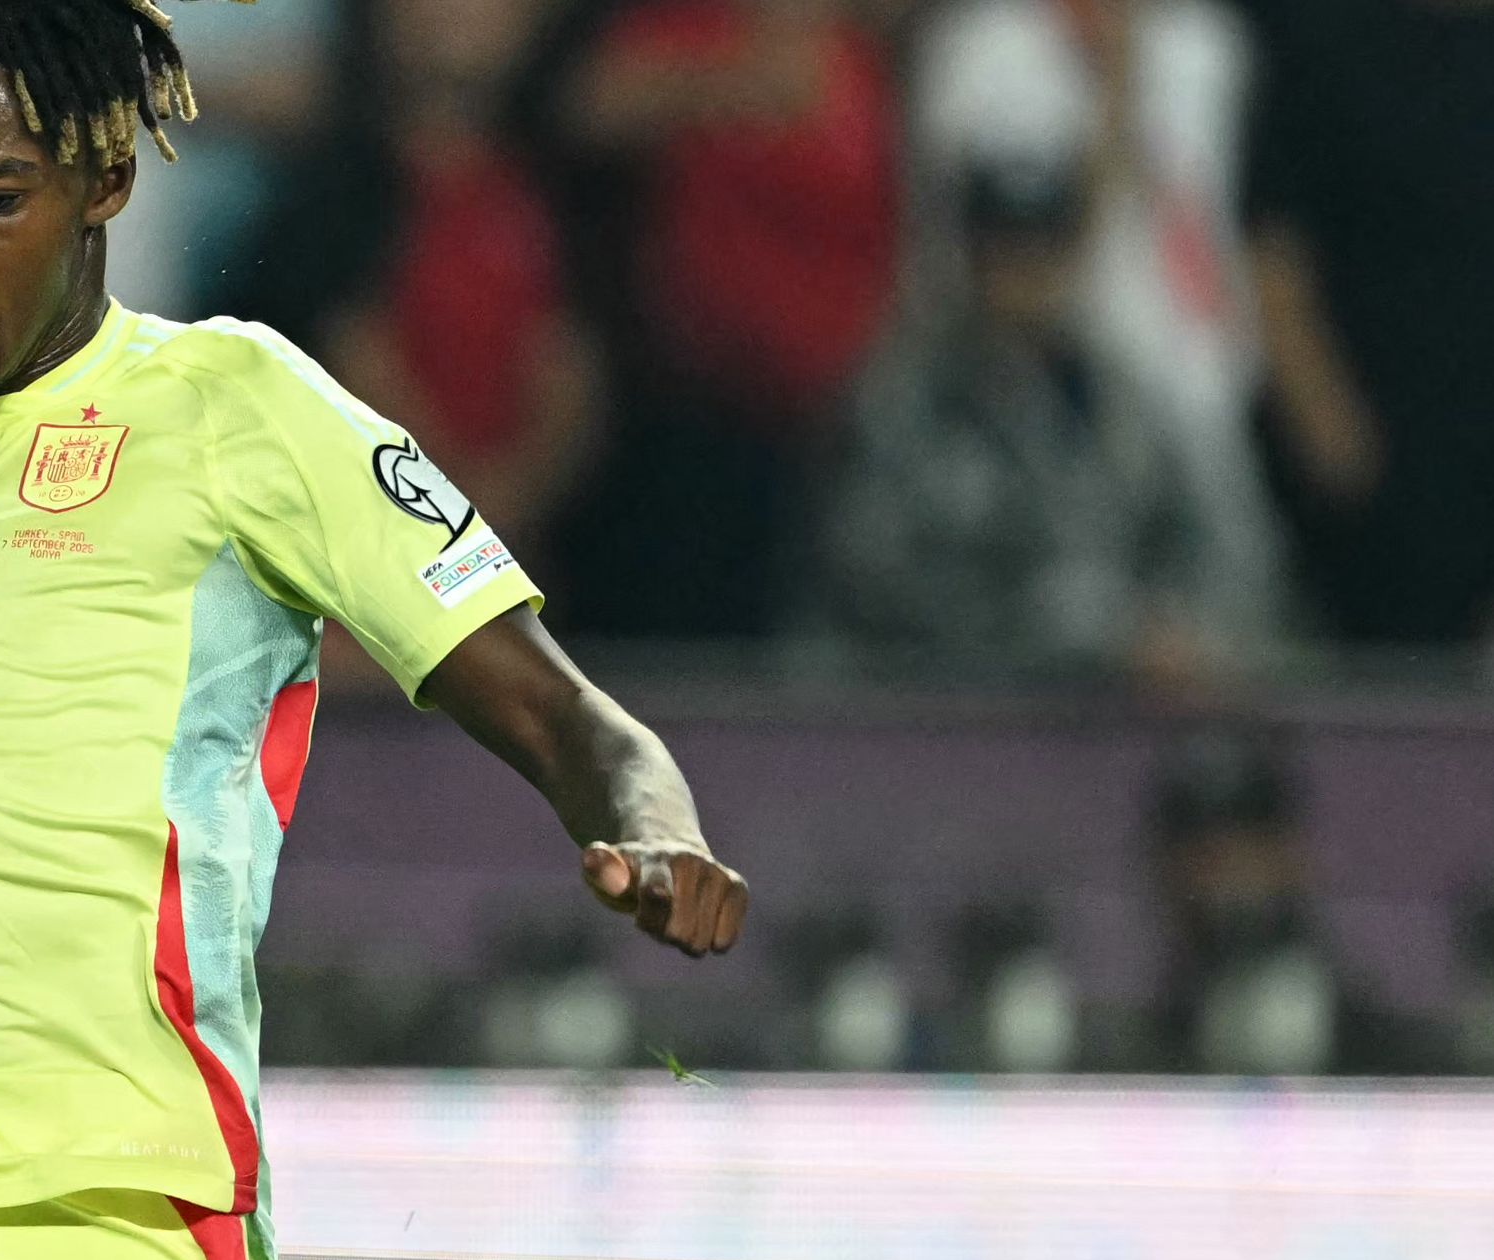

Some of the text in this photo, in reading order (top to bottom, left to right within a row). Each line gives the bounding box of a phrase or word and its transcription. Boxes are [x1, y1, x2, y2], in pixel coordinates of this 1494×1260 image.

[14, 529, 49, 539] TURKEY
[58, 530, 85, 541] SPAIN
[2, 539, 94, 553] 7 SEPTEMBER 2025
[29, 549, 61, 560] KONYA
[422, 562, 444, 579] UEFA
